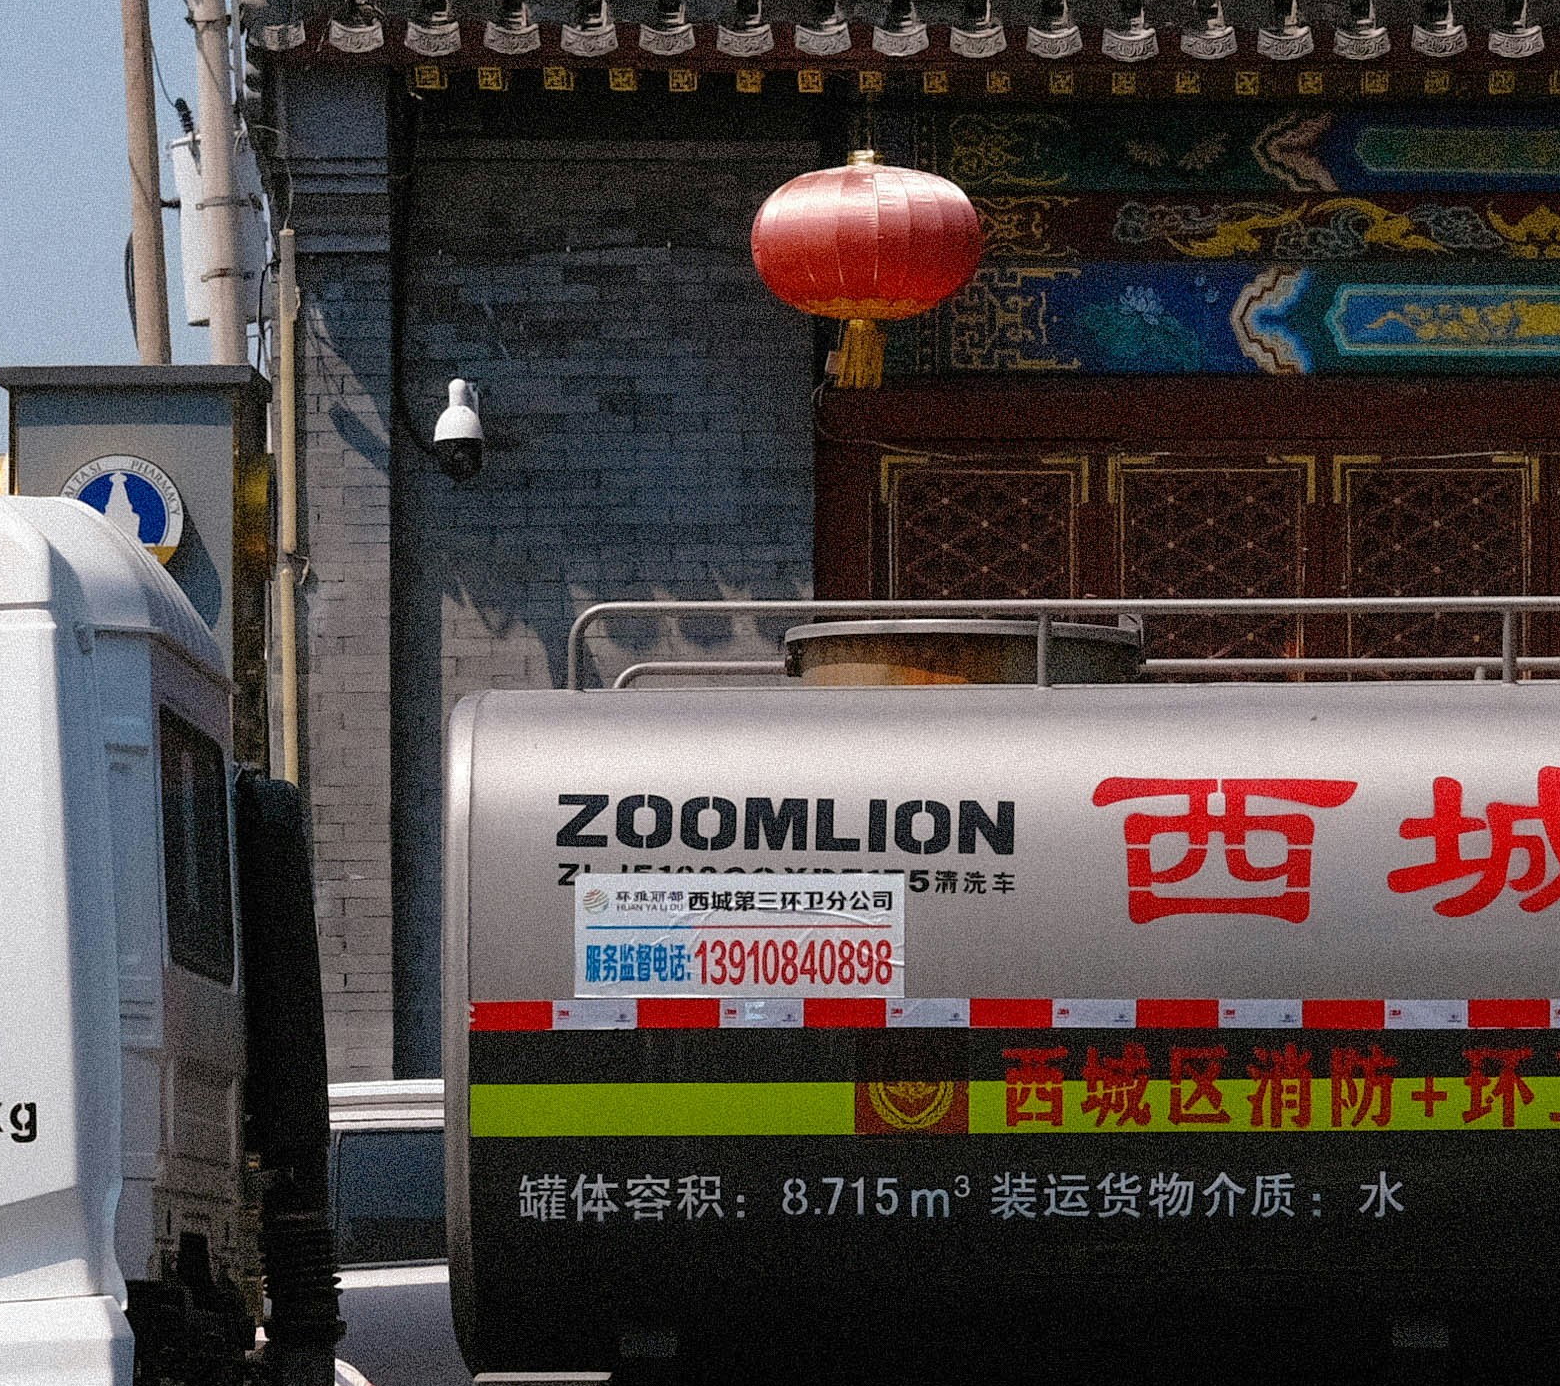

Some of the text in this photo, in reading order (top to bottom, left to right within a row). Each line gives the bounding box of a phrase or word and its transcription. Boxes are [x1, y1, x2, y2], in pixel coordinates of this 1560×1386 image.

[63, 459, 181, 517] AITASI PHARMACY
[556, 793, 1016, 856] ZOOMLION
[688, 889, 894, 912] 西城第三环卫分公司
